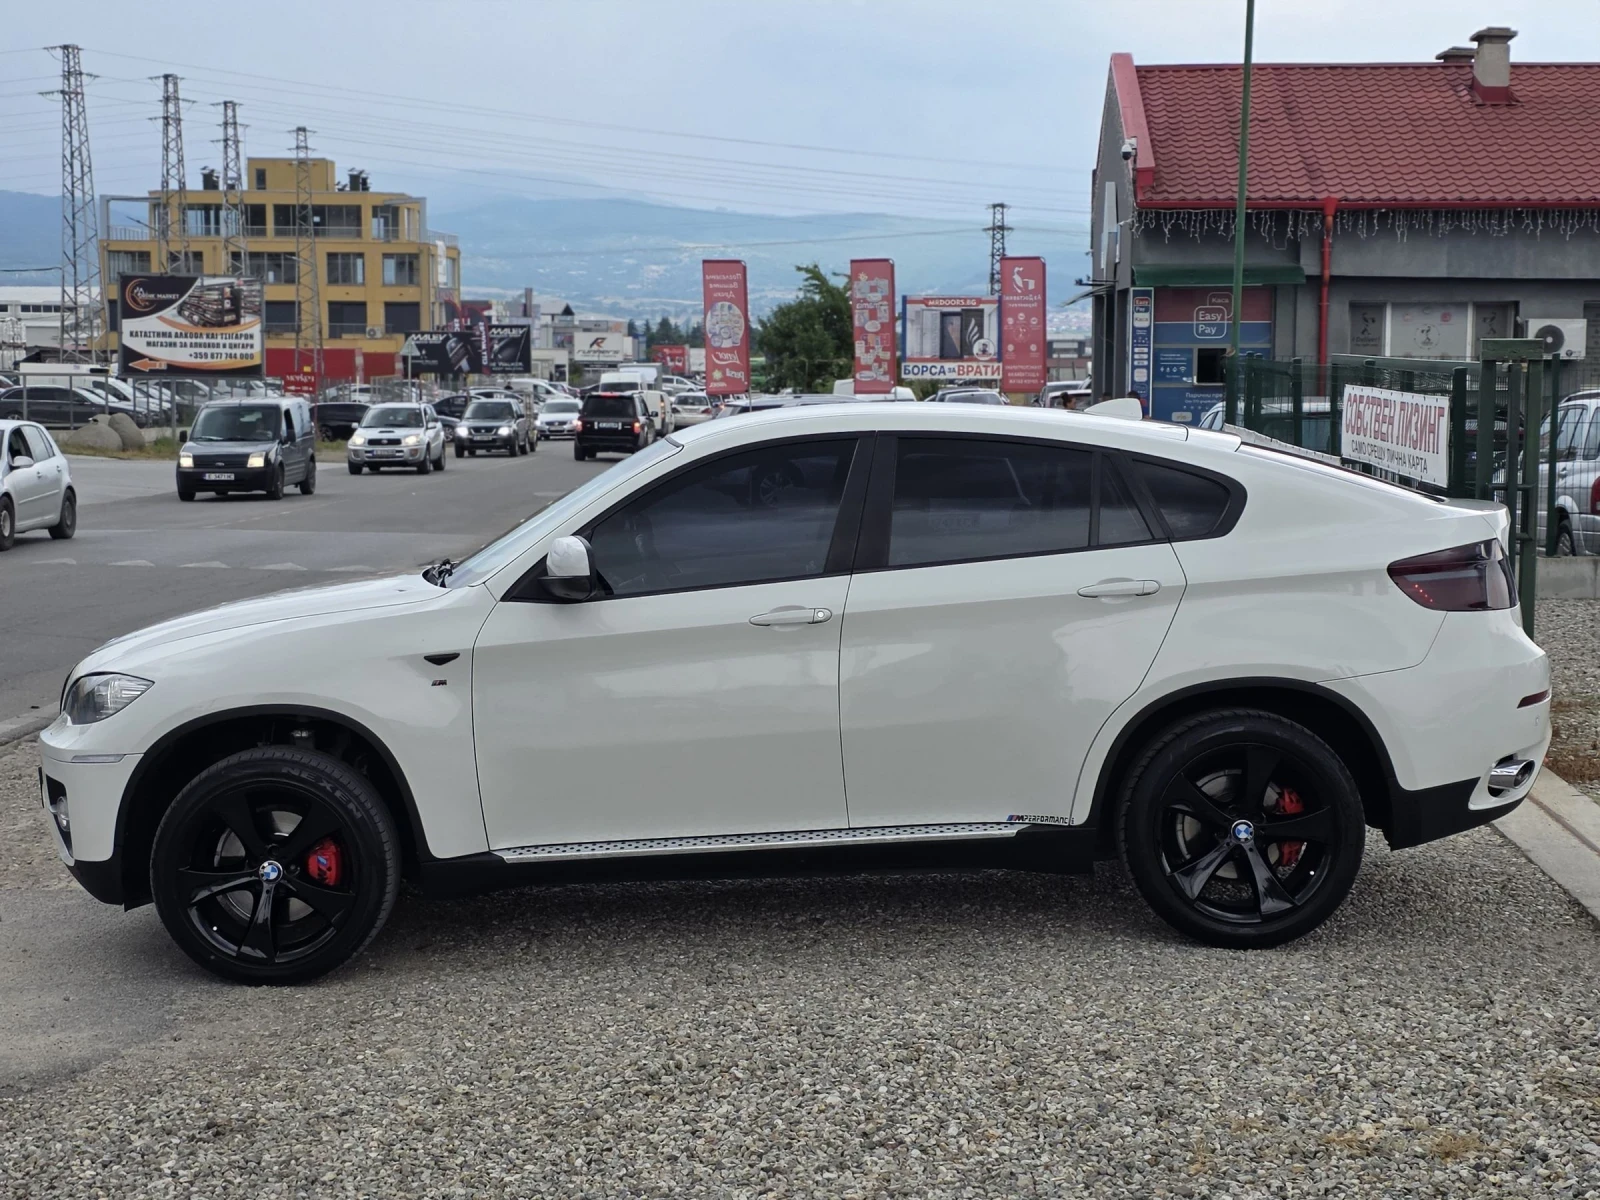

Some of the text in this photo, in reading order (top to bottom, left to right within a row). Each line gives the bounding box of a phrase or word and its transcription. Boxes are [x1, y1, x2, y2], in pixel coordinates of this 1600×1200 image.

[1199, 311, 1222, 322] Easy
[1199, 324, 1217, 335] Pay
[146, 340, 178, 348] МАГАЗИН
[228, 342, 254, 350] ЦИГАРИ
[189, 351, 209, 360] +359
[903, 365, 946, 376] БОРСА
[957, 365, 1001, 376] ВРАТИ
[1345, 393, 1445, 455] СОБСТВЕН ЛИЗИНГ
[1352, 440, 1428, 474] САМО СРЕЩУ ЛИЧНА КАРТА
[281, 766, 362, 819] NEXEN
